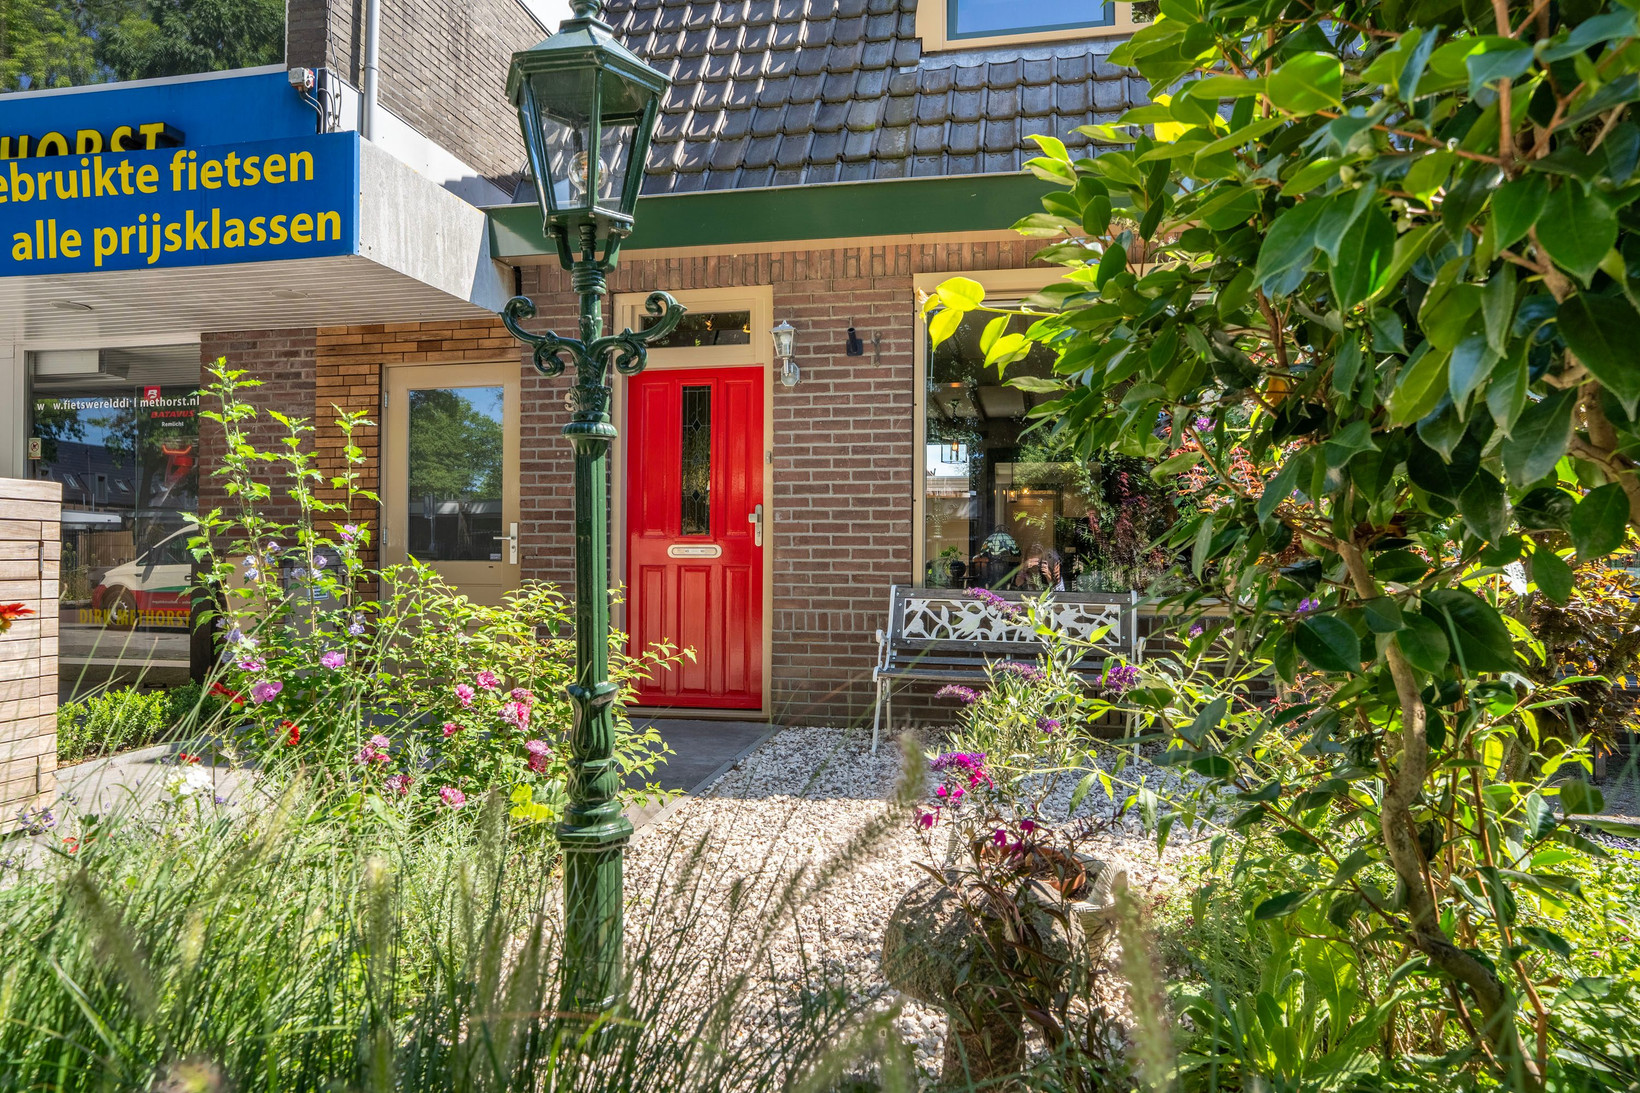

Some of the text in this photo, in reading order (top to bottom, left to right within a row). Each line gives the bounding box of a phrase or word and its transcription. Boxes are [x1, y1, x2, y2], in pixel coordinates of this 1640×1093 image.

[170, 150, 314, 191] fietsen
[12, 208, 341, 267] alle prijsklassen
[151, 409, 195, 419] BATAVUS
